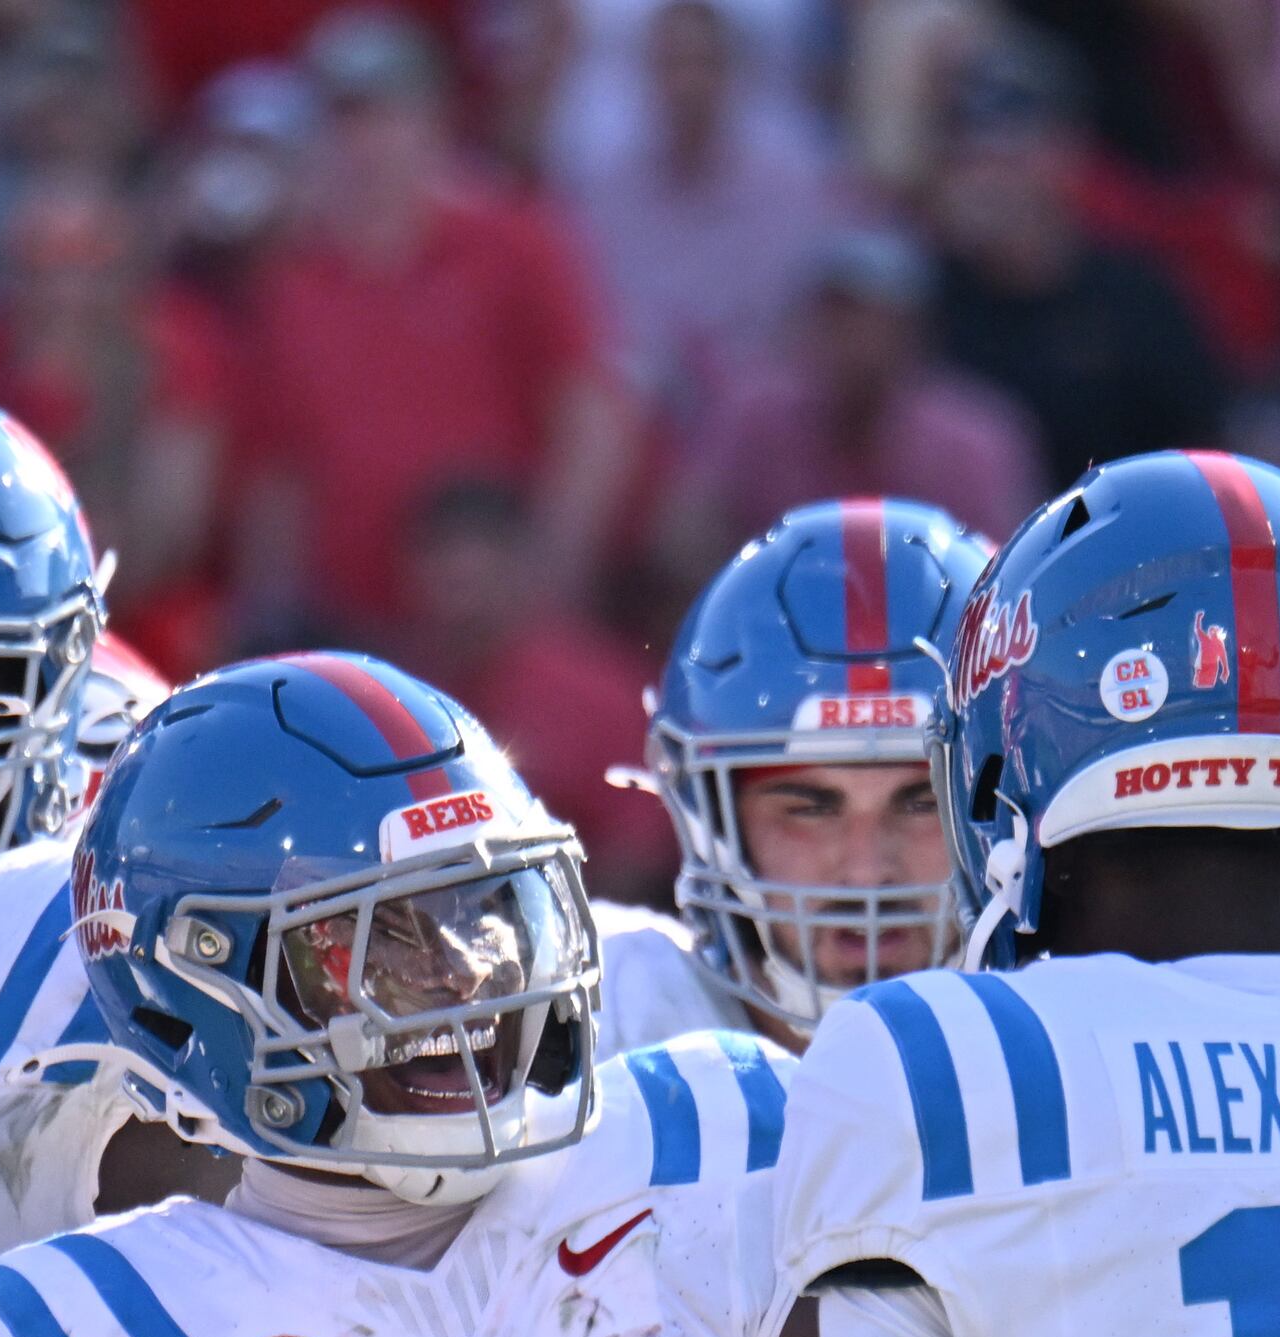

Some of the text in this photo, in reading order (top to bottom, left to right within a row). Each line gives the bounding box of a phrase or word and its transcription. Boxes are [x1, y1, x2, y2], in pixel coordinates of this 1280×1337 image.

[953, 580, 1037, 716] Miss
[1115, 658, 1150, 682] CA
[821, 699, 914, 727] REBS
[1121, 688, 1151, 711] 91
[1114, 758, 1256, 799] HOTTY
[401, 793, 495, 840] REBS
